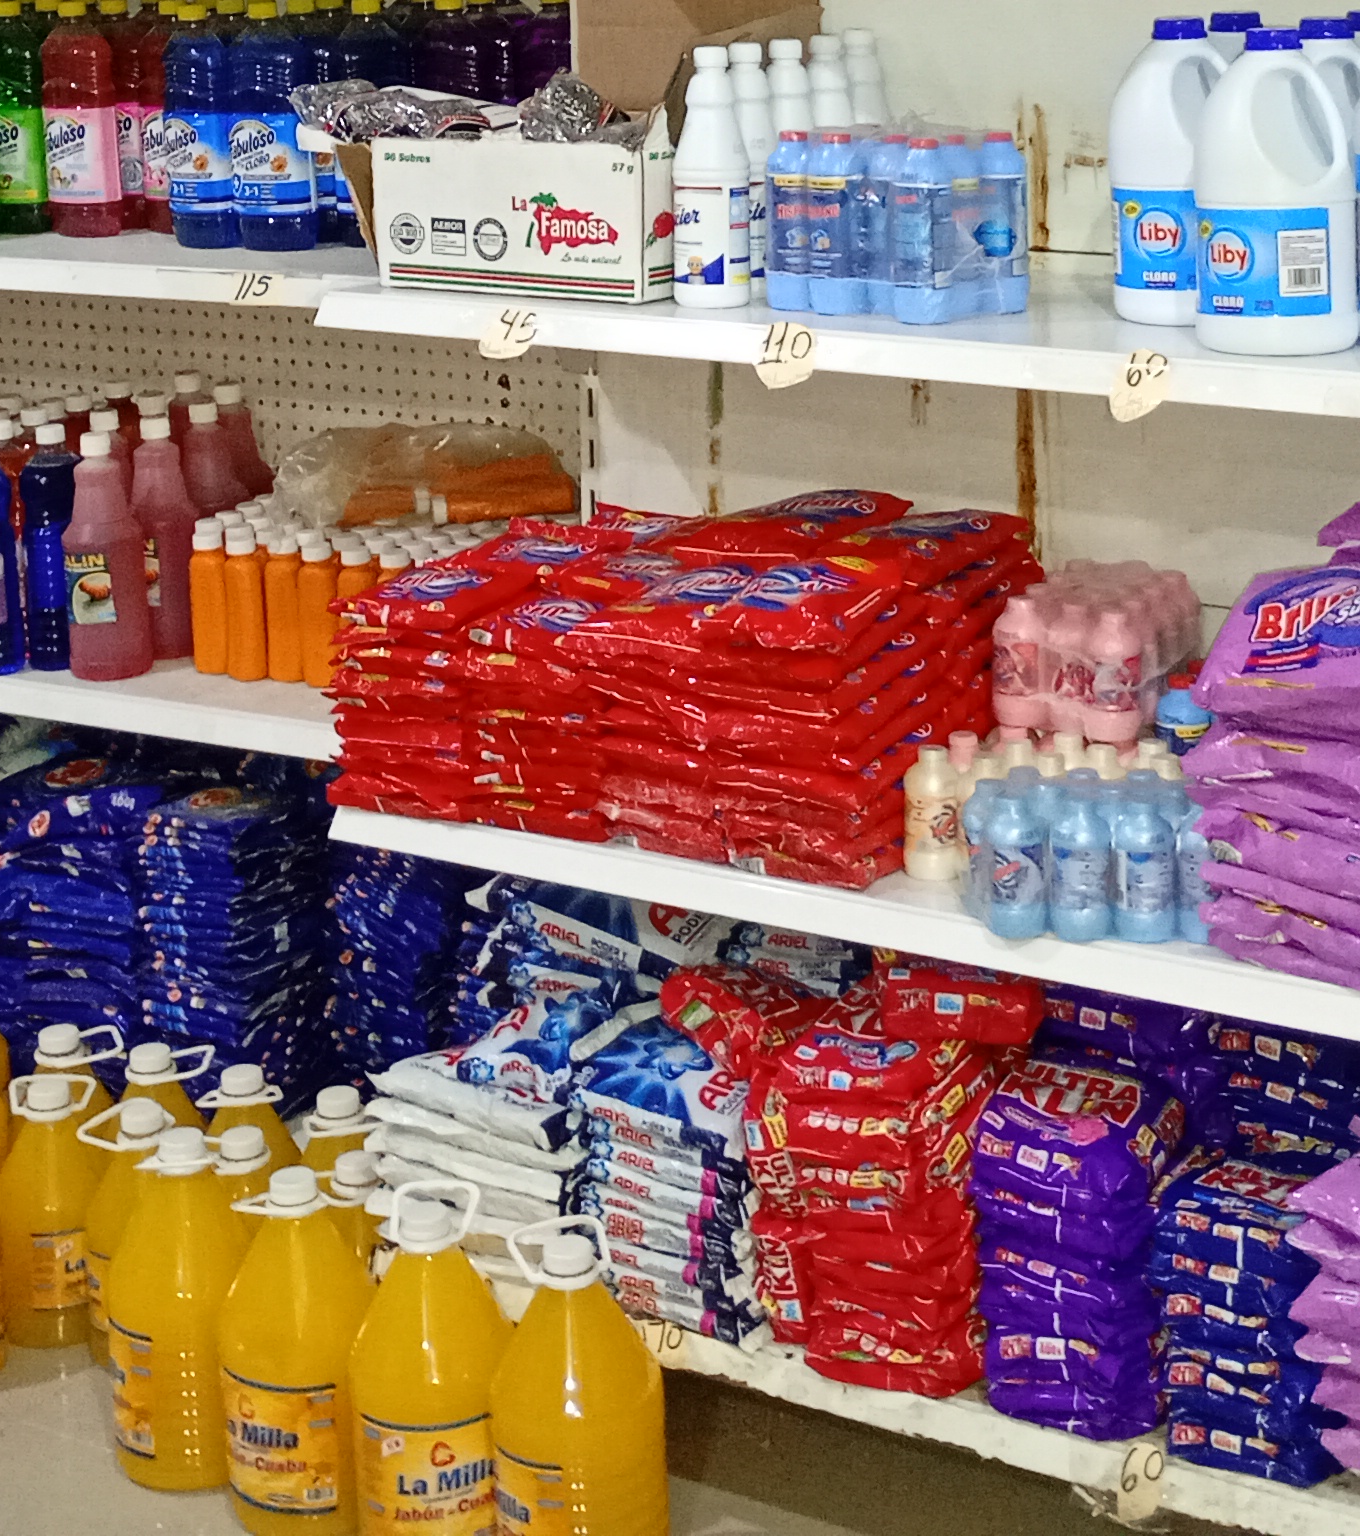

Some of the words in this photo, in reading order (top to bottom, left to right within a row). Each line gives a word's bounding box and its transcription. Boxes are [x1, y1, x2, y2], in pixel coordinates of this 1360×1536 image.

[511, 195, 528, 212] La
[540, 211, 610, 241] Famosa
[1138, 222, 1180, 251] Liby
[1208, 242, 1248, 273] Liby
[235, 273, 273, 301] 115
[1142, 270, 1177, 283] CLORO
[1211, 295, 1245, 309] CLORO
[502, 309, 538, 343] 45
[761, 324, 813, 364] 110
[539, 921, 585, 950] ARIEL
[766, 932, 810, 952] ARIEL
[616, 1150, 660, 1175] ARIEL
[613, 1175, 654, 1201] ARIEL
[618, 1274, 661, 1297] ARIEL
[240, 1424, 299, 1449] Milla
[1119, 1447, 1165, 1494] 60
[397, 1474, 428, 1496] La
